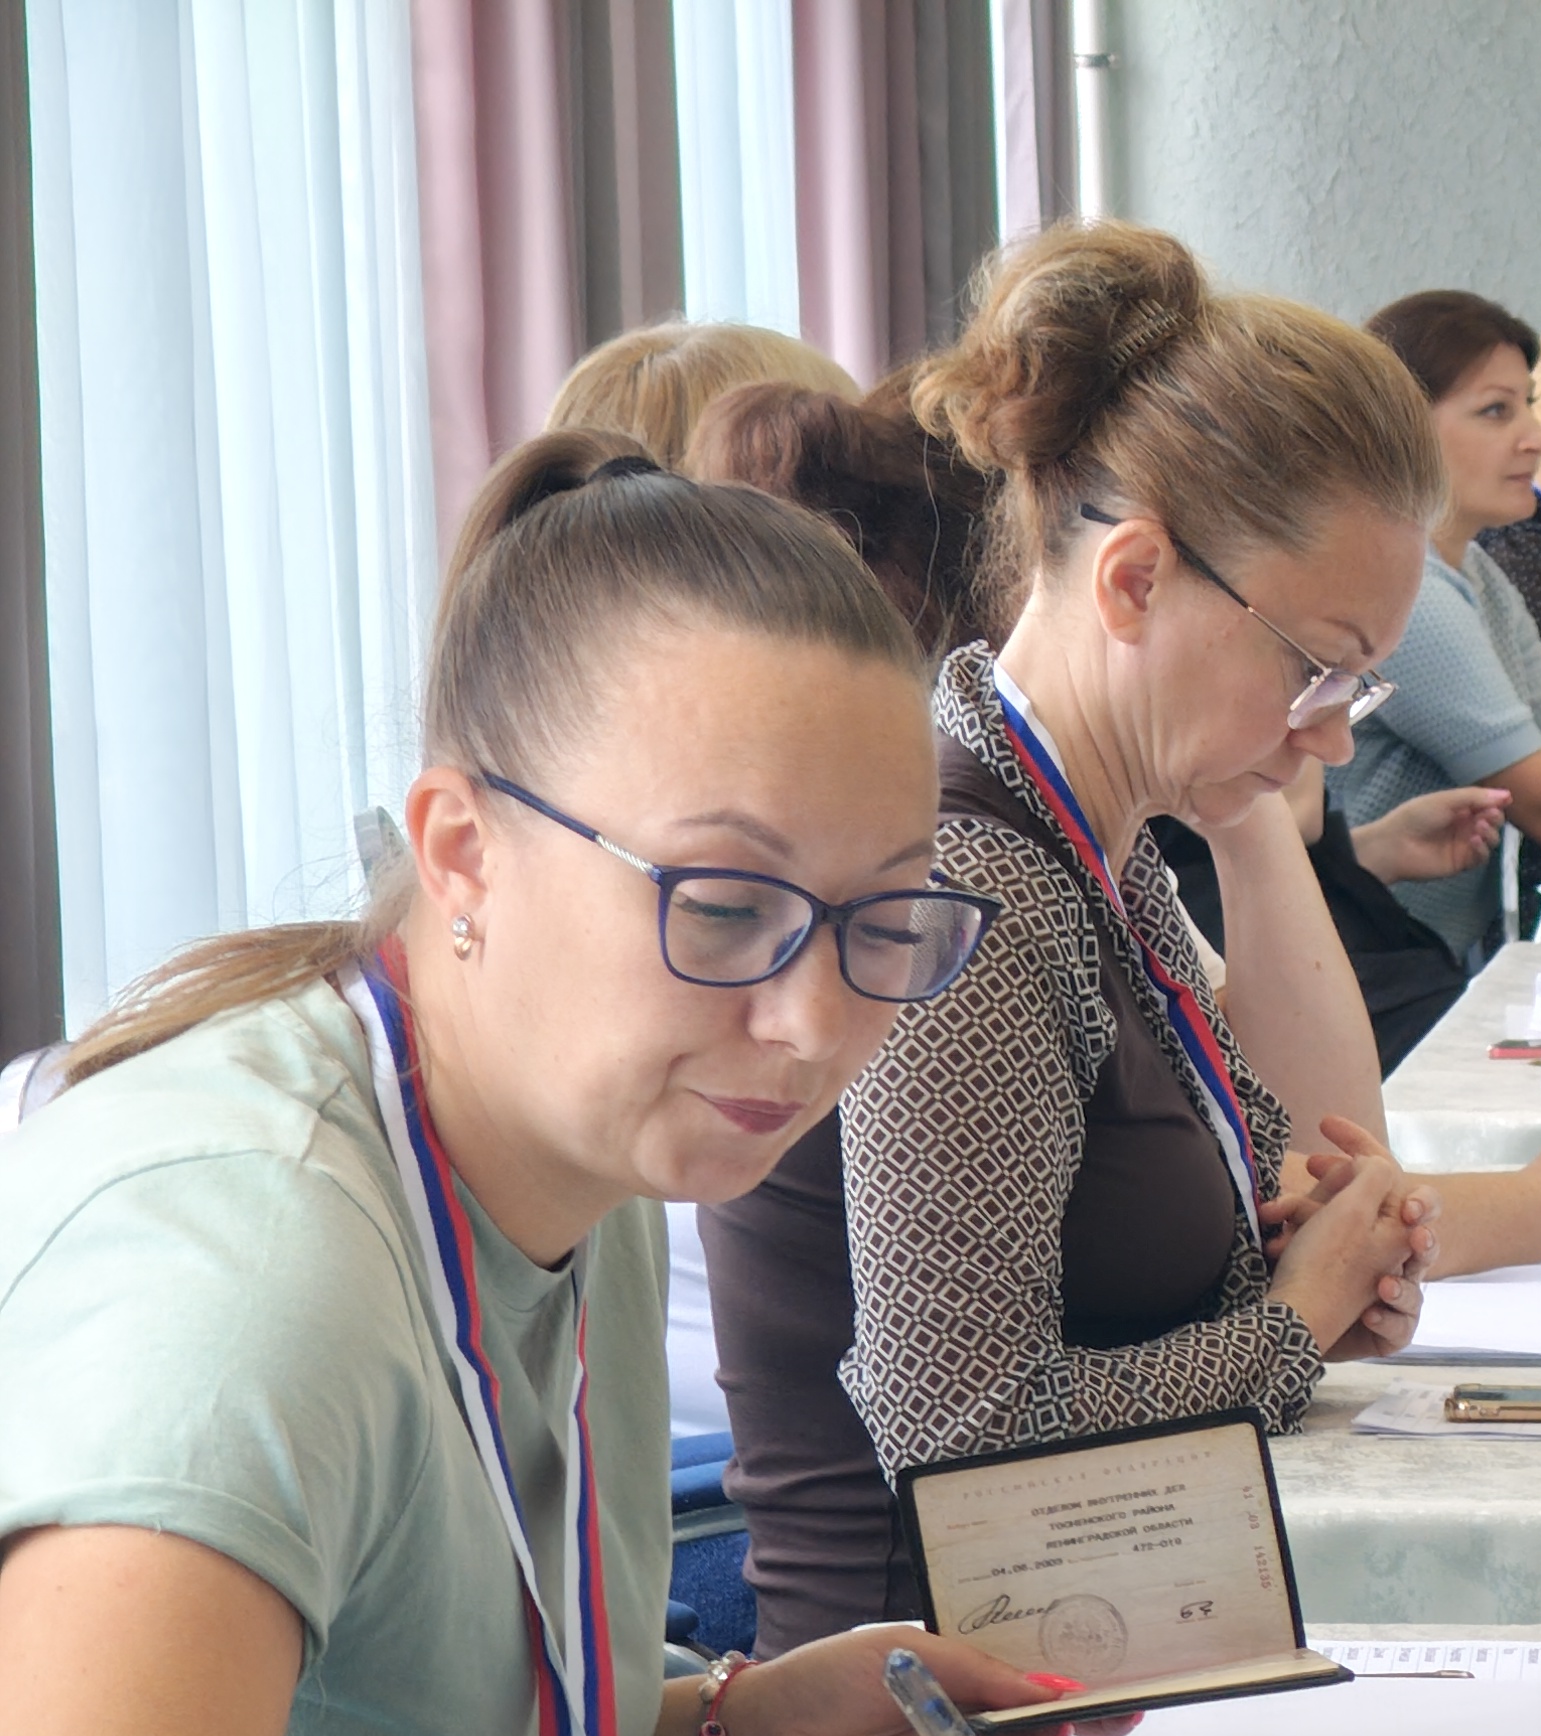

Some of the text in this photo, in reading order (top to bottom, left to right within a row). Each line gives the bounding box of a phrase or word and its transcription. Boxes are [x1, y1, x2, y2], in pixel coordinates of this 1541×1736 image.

[1132, 1502, 1176, 1518] РАЙОНА
[1046, 1516, 1194, 1550] ЛЕНИНГРАДСКОЙ ОБЛАСТИ
